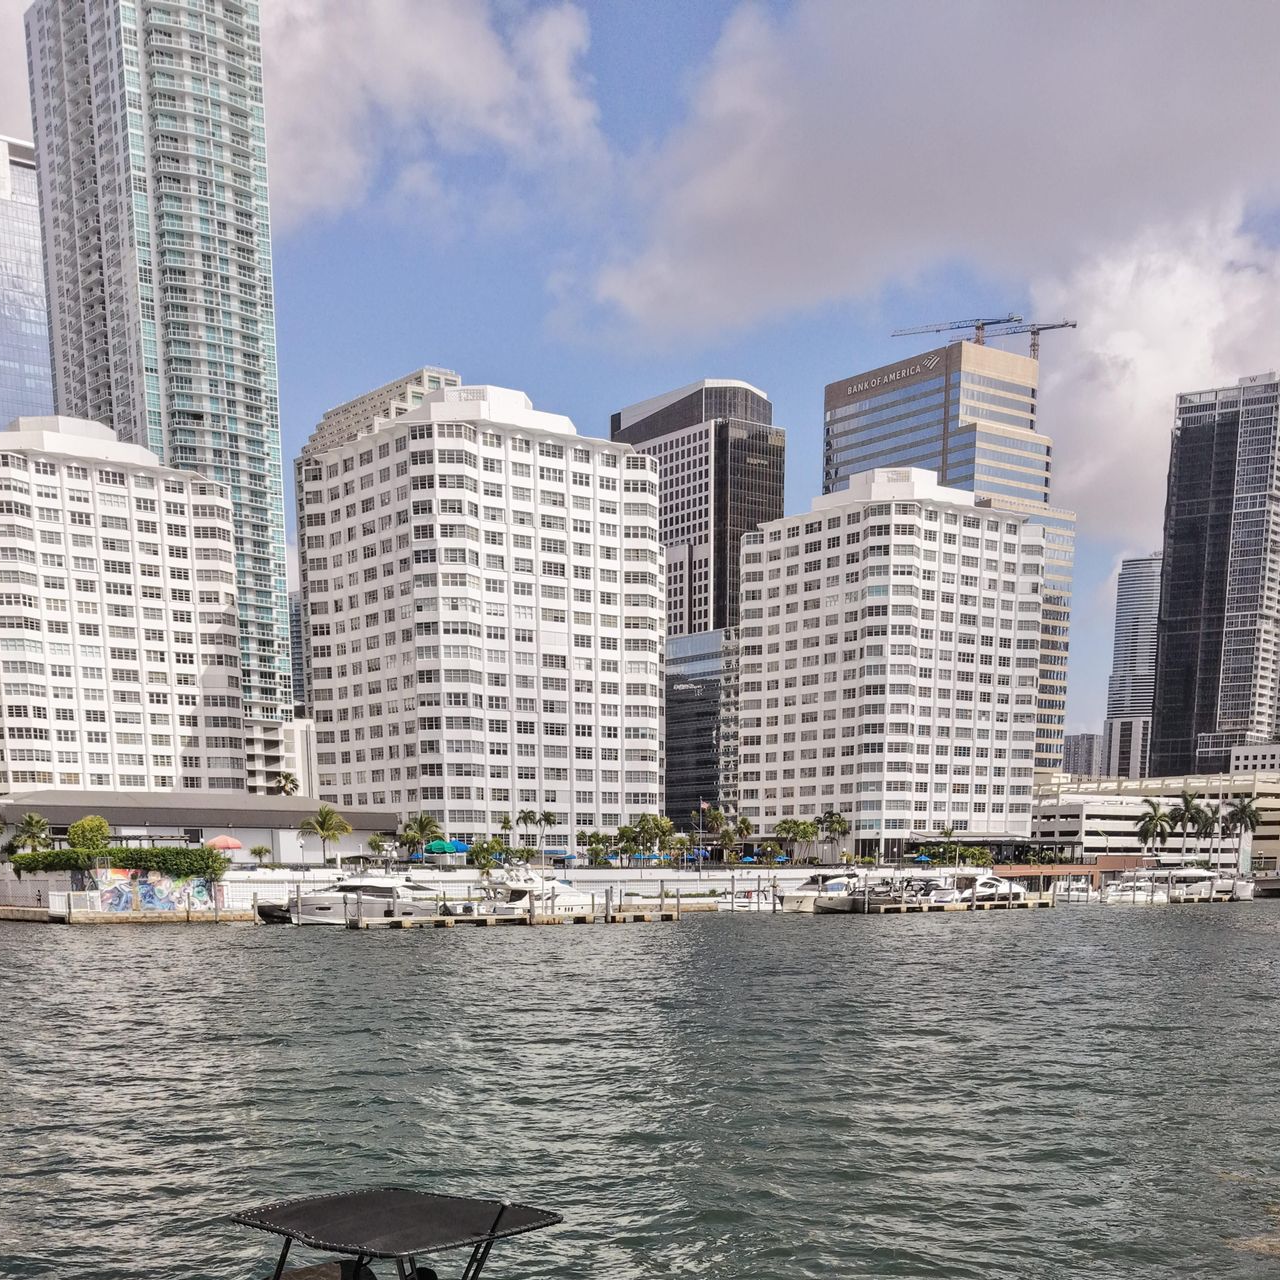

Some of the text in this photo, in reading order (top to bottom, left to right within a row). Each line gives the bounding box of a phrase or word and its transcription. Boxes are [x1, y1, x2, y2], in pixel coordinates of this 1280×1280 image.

[847, 365, 921, 395] BANK OF AMERICA
